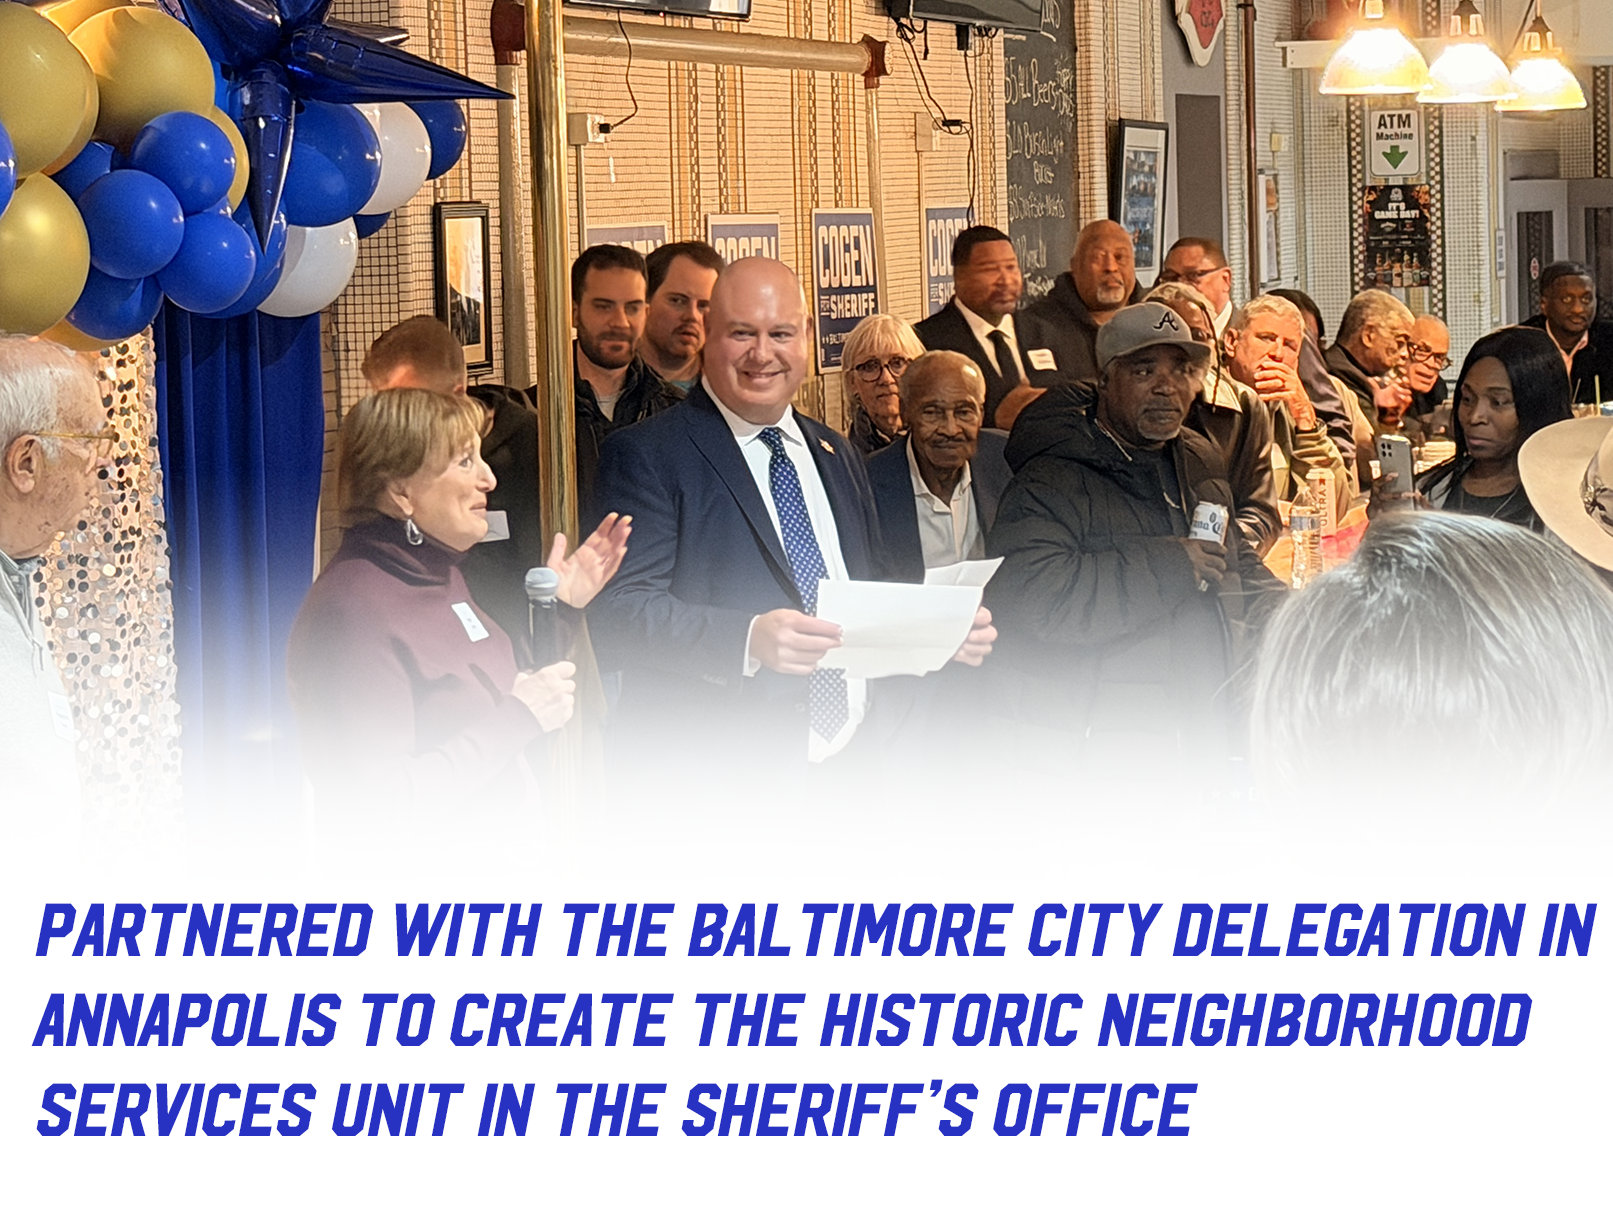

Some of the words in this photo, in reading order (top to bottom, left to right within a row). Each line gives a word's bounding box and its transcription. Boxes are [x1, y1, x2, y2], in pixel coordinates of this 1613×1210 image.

[1376, 131, 1414, 141] Machine
[1377, 113, 1411, 130] ATM
[818, 224, 874, 289] COGEN
[928, 218, 968, 277] COG
[830, 292, 875, 320] SHERIFF
[1318, 488, 1328, 527] ULTRA
